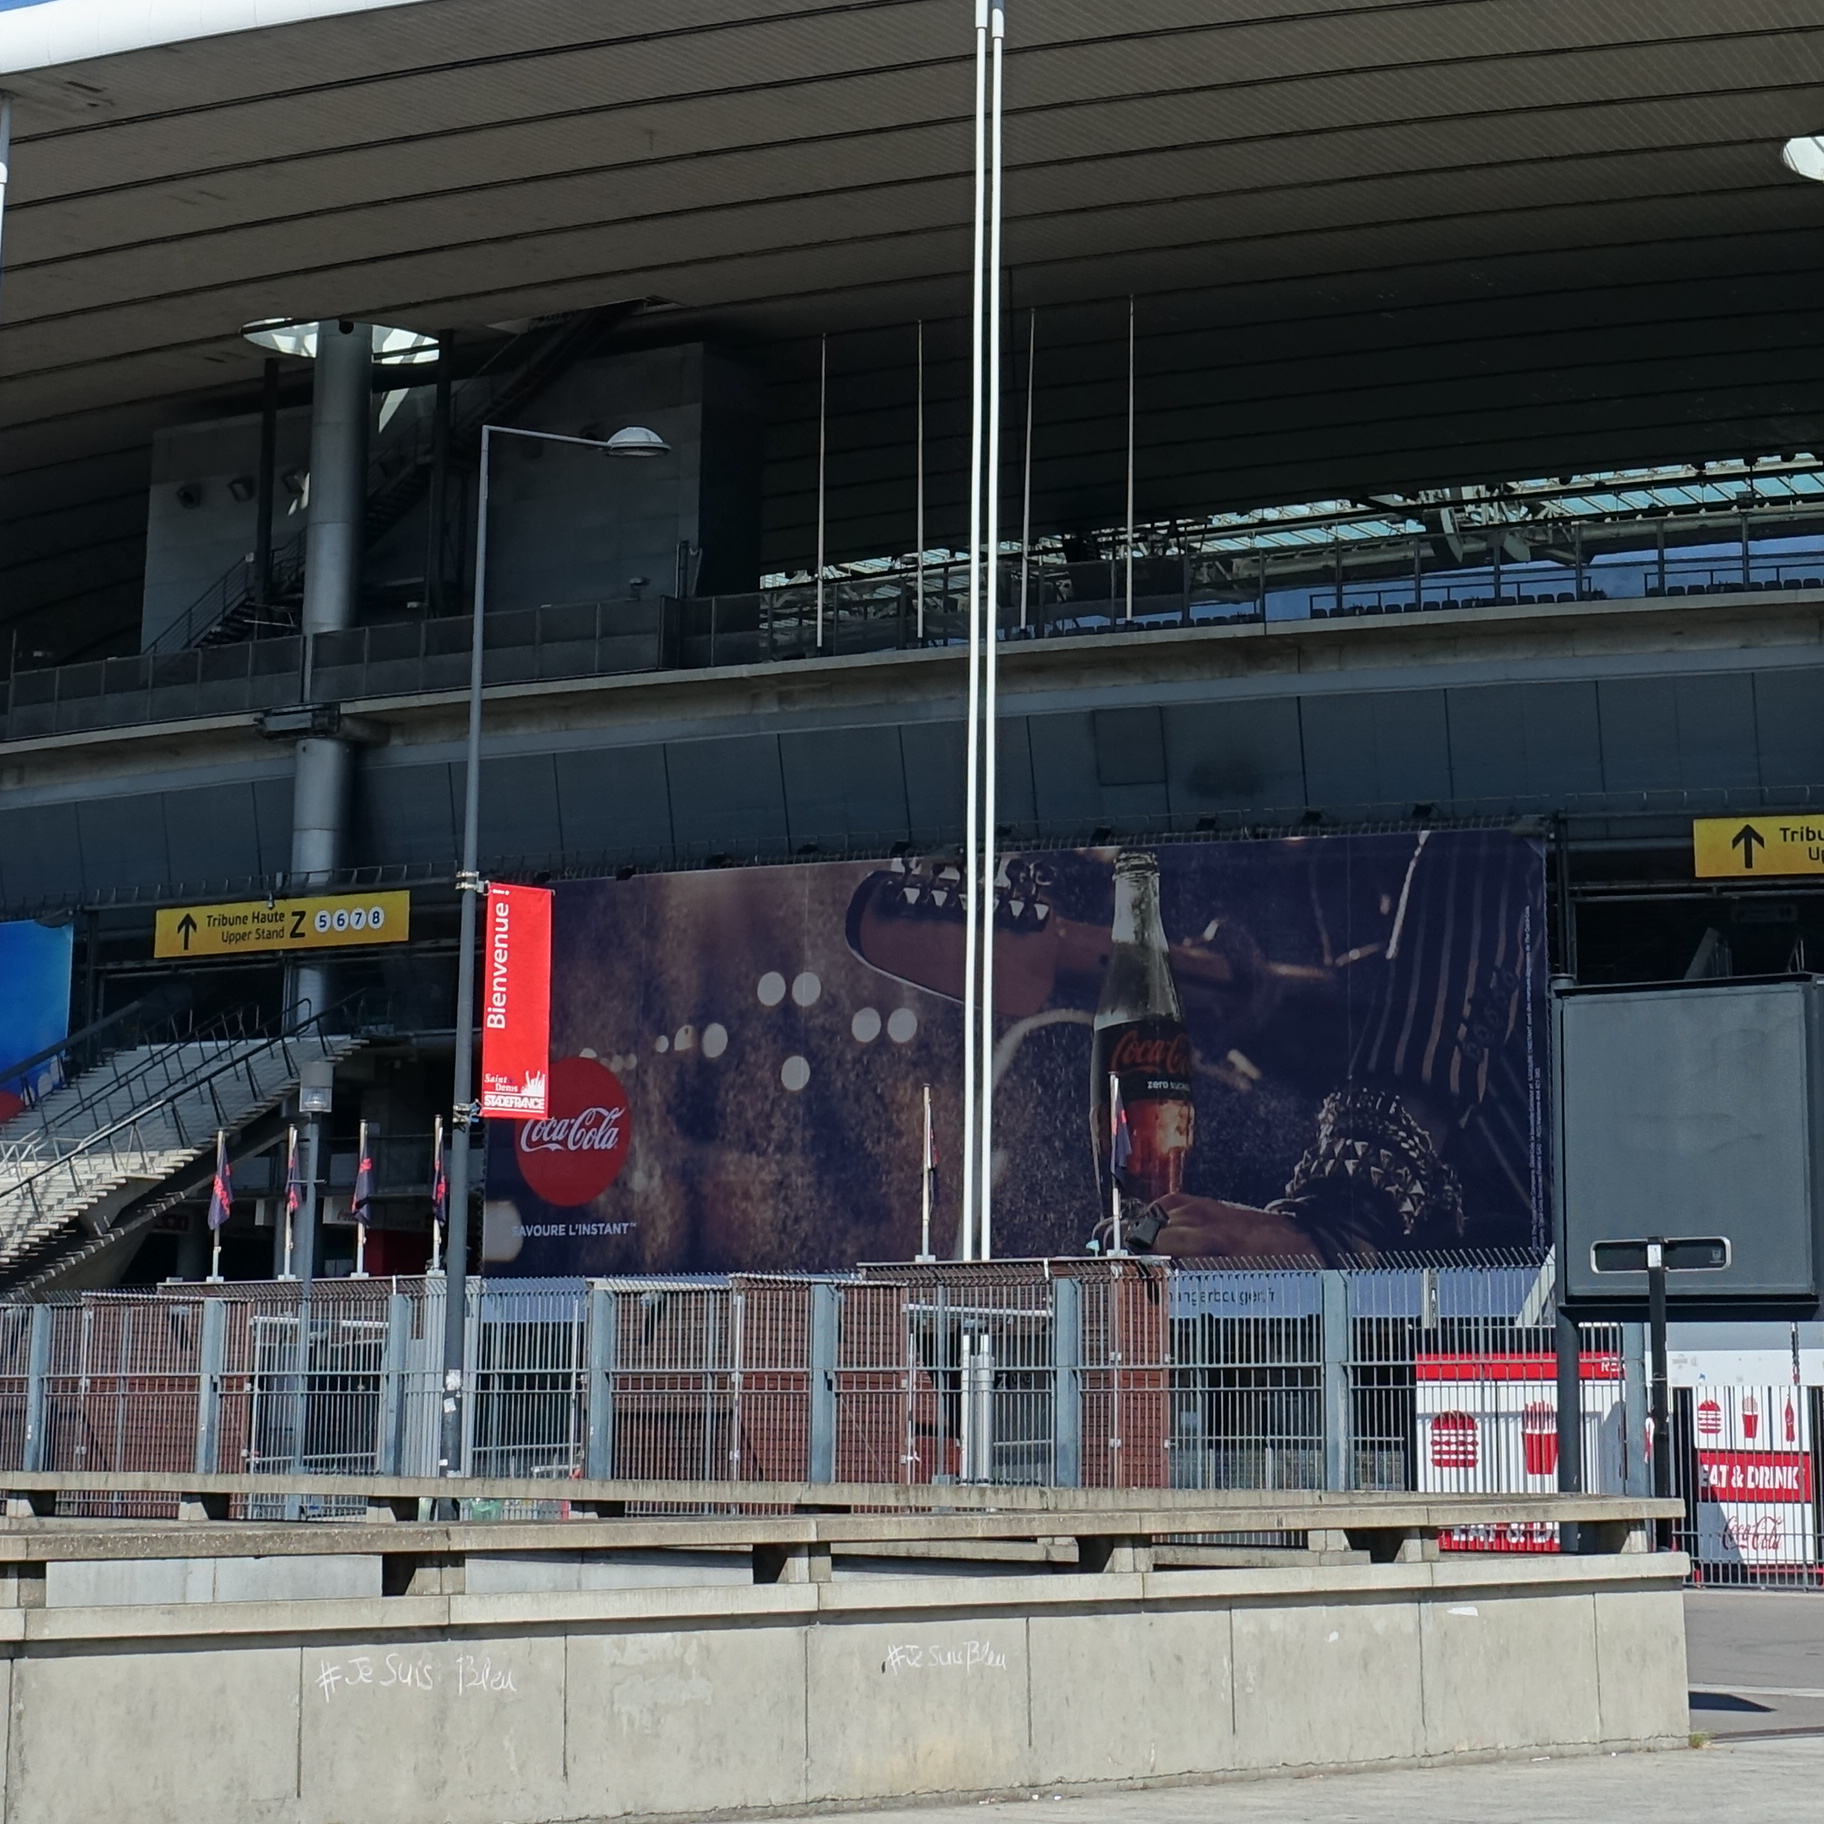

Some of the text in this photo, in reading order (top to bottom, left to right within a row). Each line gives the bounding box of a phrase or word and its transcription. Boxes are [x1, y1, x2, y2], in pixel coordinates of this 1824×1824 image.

[207, 914, 248, 927] Tribune
[252, 911, 285, 924] Haute
[290, 911, 306, 938] Z
[221, 927, 285, 945] Upper Stand
[487, 902, 509, 1029] Bienvenue
[484, 1073, 507, 1083] Saint
[495, 1082, 518, 1093] Denis
[1147, 1081, 1169, 1089] zero
[521, 1107, 625, 1152] Coca-Cola
[513, 1224, 566, 1237] SAVOURE
[1701, 1464, 1799, 1489] EAT & DRINK
[1722, 1516, 1784, 1551] Coca-Cola
